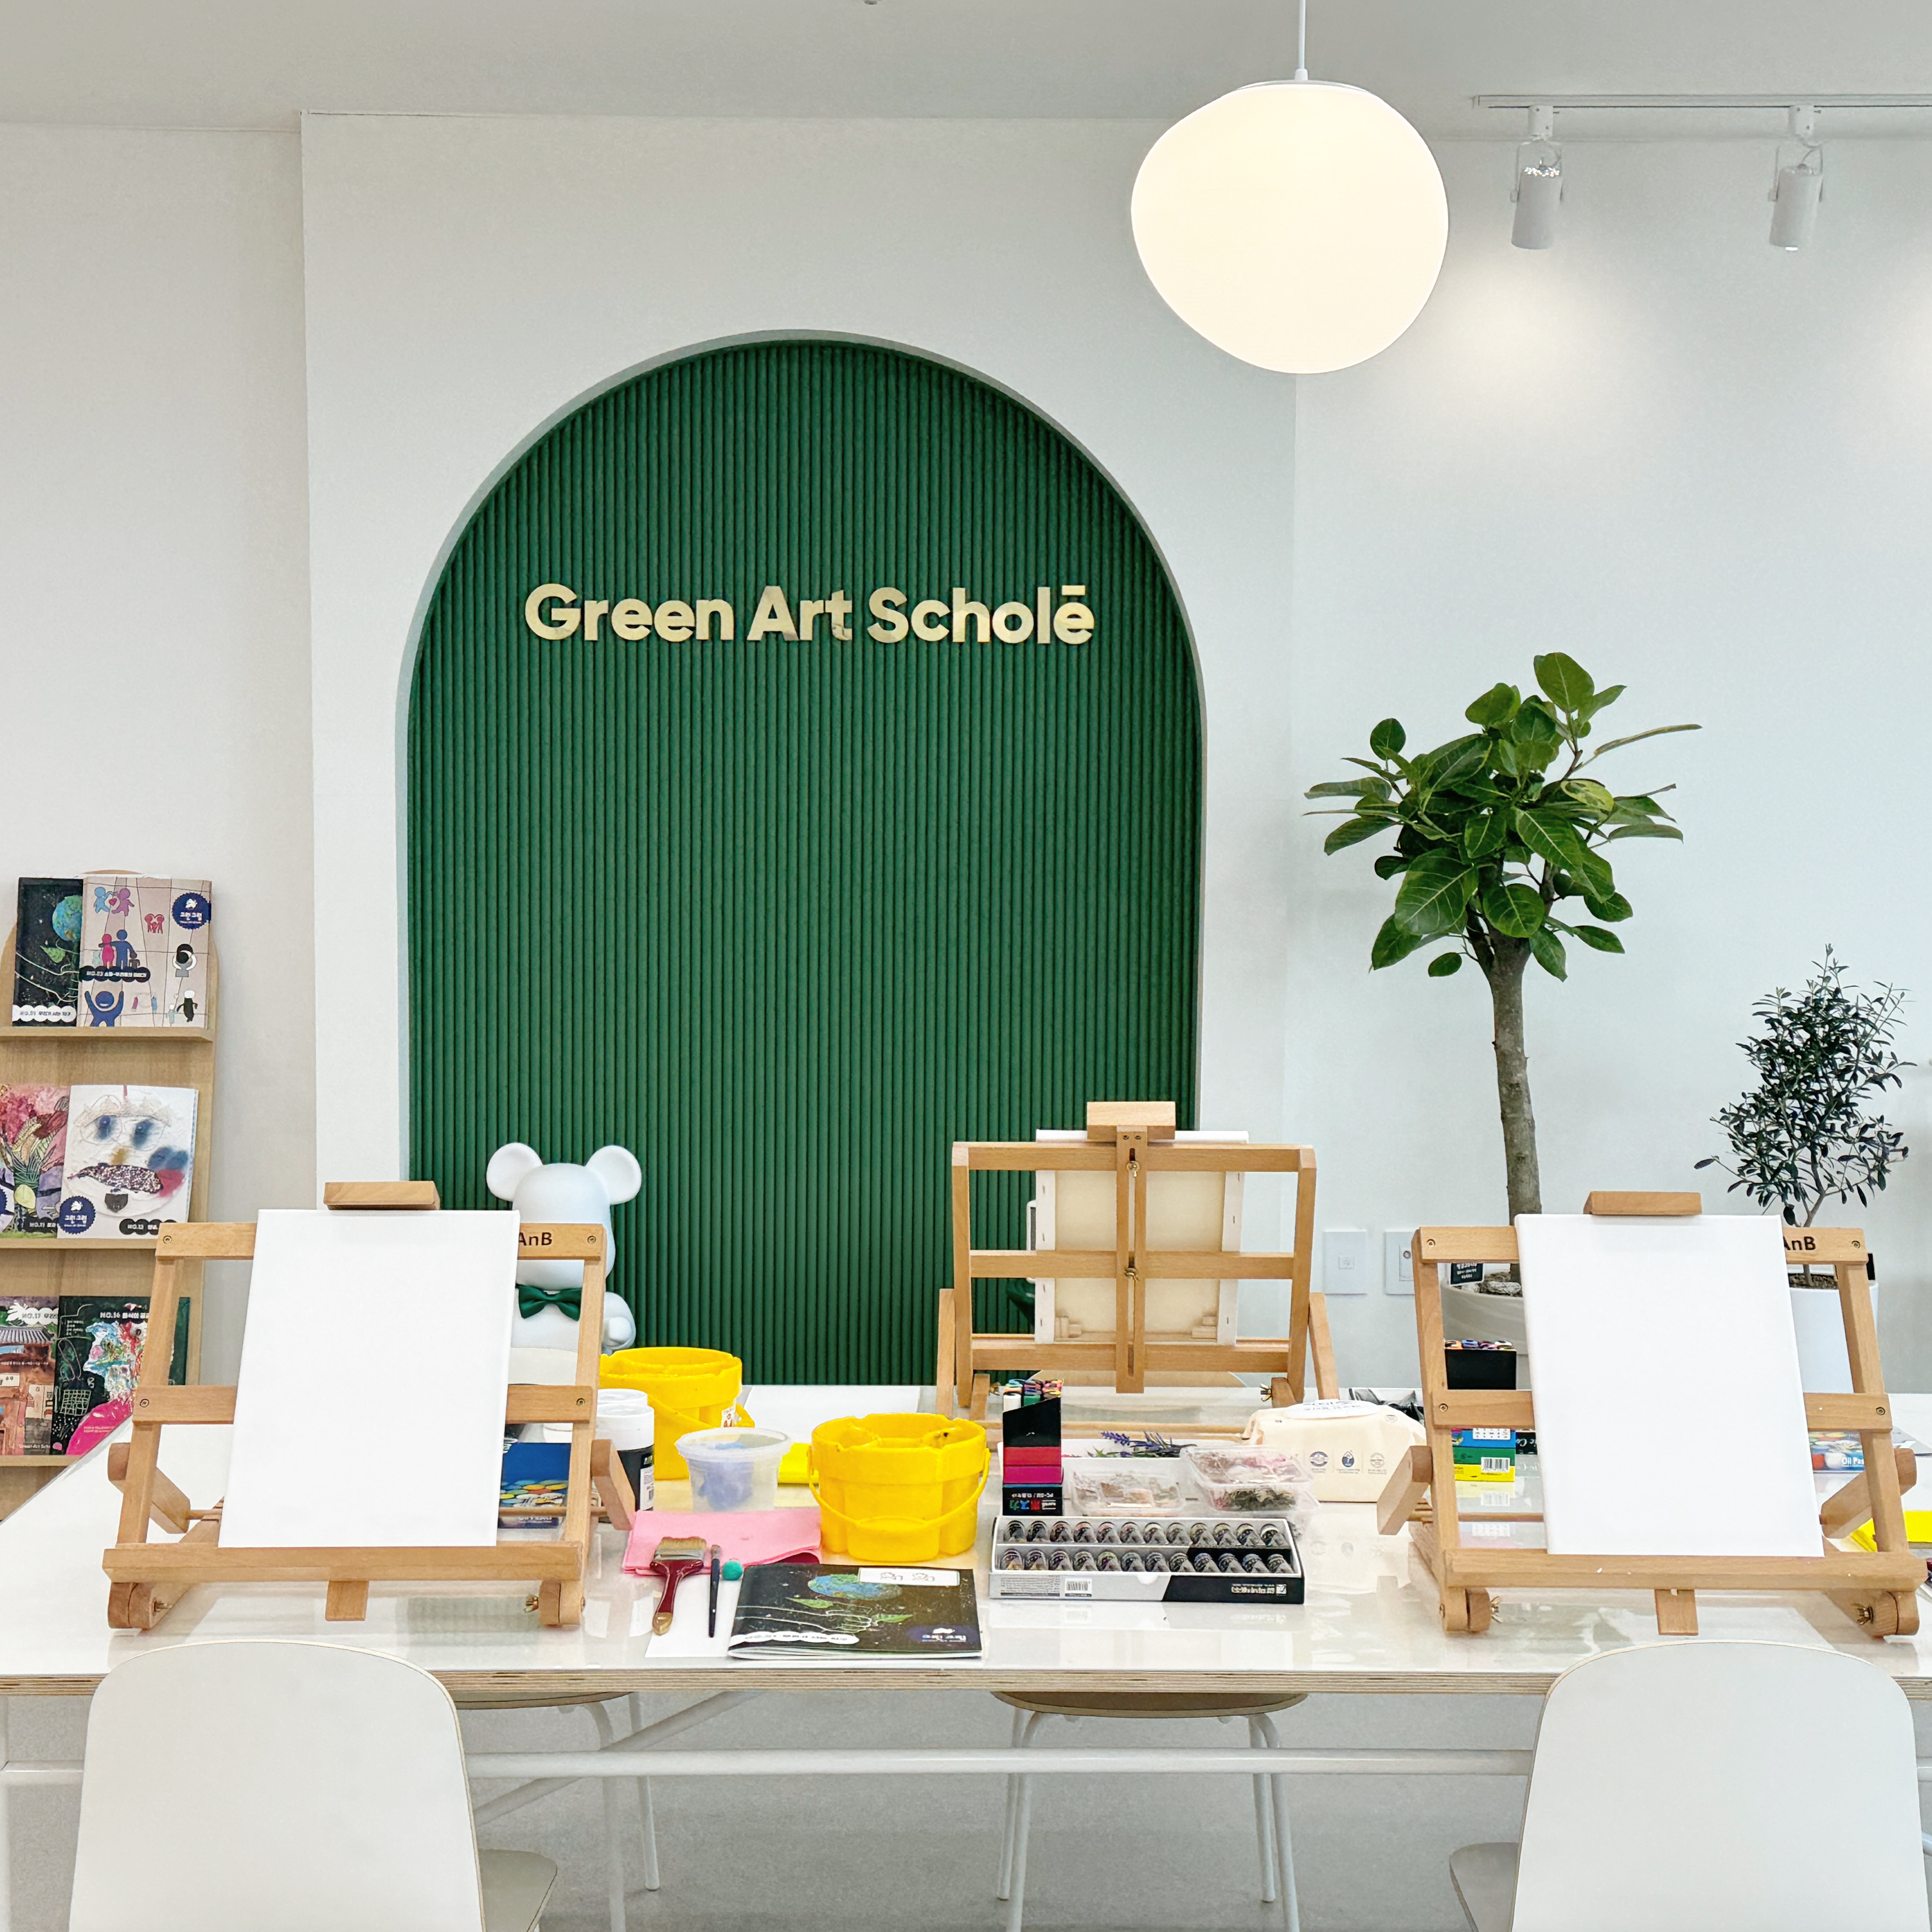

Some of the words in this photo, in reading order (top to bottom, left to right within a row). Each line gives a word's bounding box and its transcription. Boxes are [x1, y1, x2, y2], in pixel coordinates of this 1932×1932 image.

[525, 583, 735, 641] Green
[747, 585, 853, 643] Art
[868, 585, 1095, 645] Scholē
[518, 1232, 552, 1246] AnB
[1841, 1457, 1852, 1465] Oil
